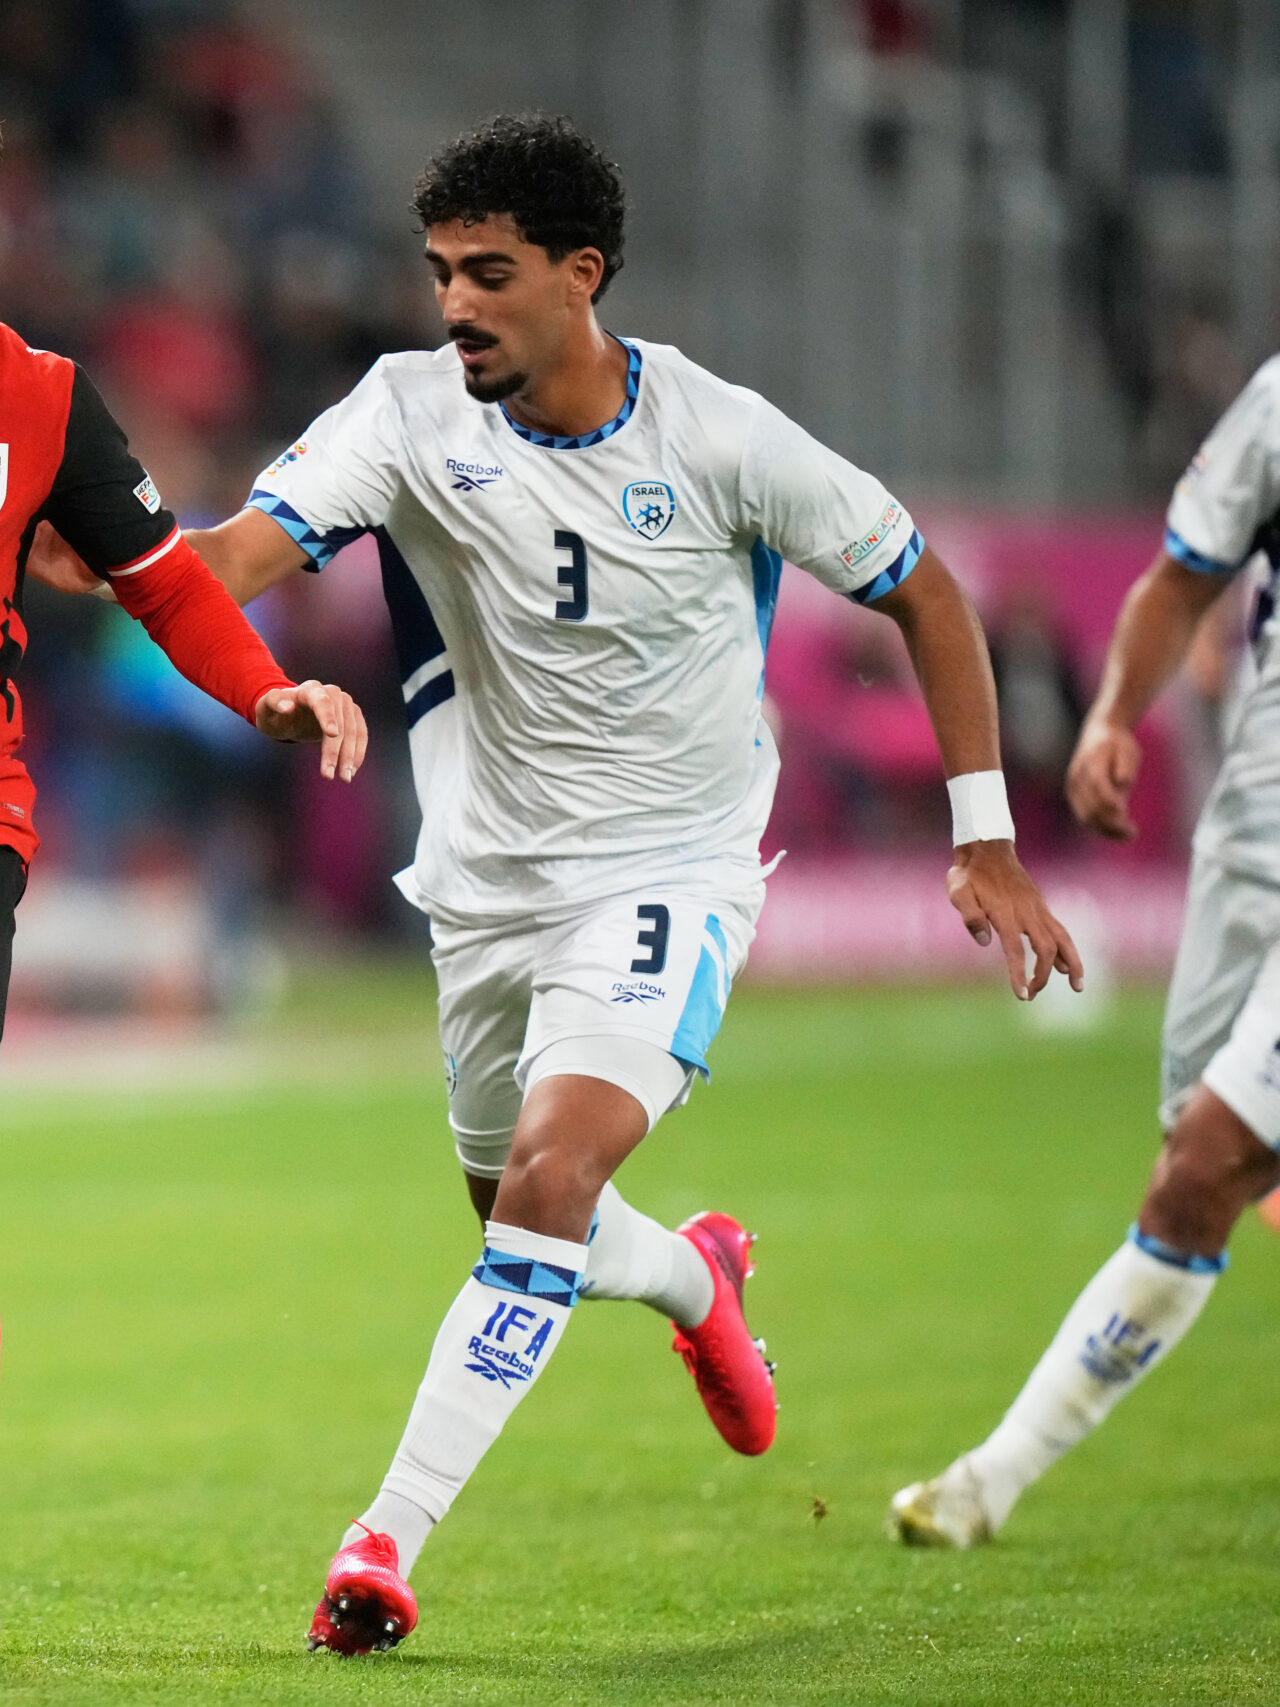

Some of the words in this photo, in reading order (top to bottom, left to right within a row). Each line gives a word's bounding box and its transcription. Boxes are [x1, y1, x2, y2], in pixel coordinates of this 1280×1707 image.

[446, 458, 504, 478] Reebok
[631, 486, 665, 496] ISRAEL
[841, 541, 858, 556] UEFA
[844, 501, 898, 565] FOUNDATION
[554, 529, 589, 623] 3
[630, 904, 671, 976] 3
[611, 981, 666, 998] Reebok
[481, 1301, 555, 1362] IFA
[467, 1335, 534, 1378] Reebok
